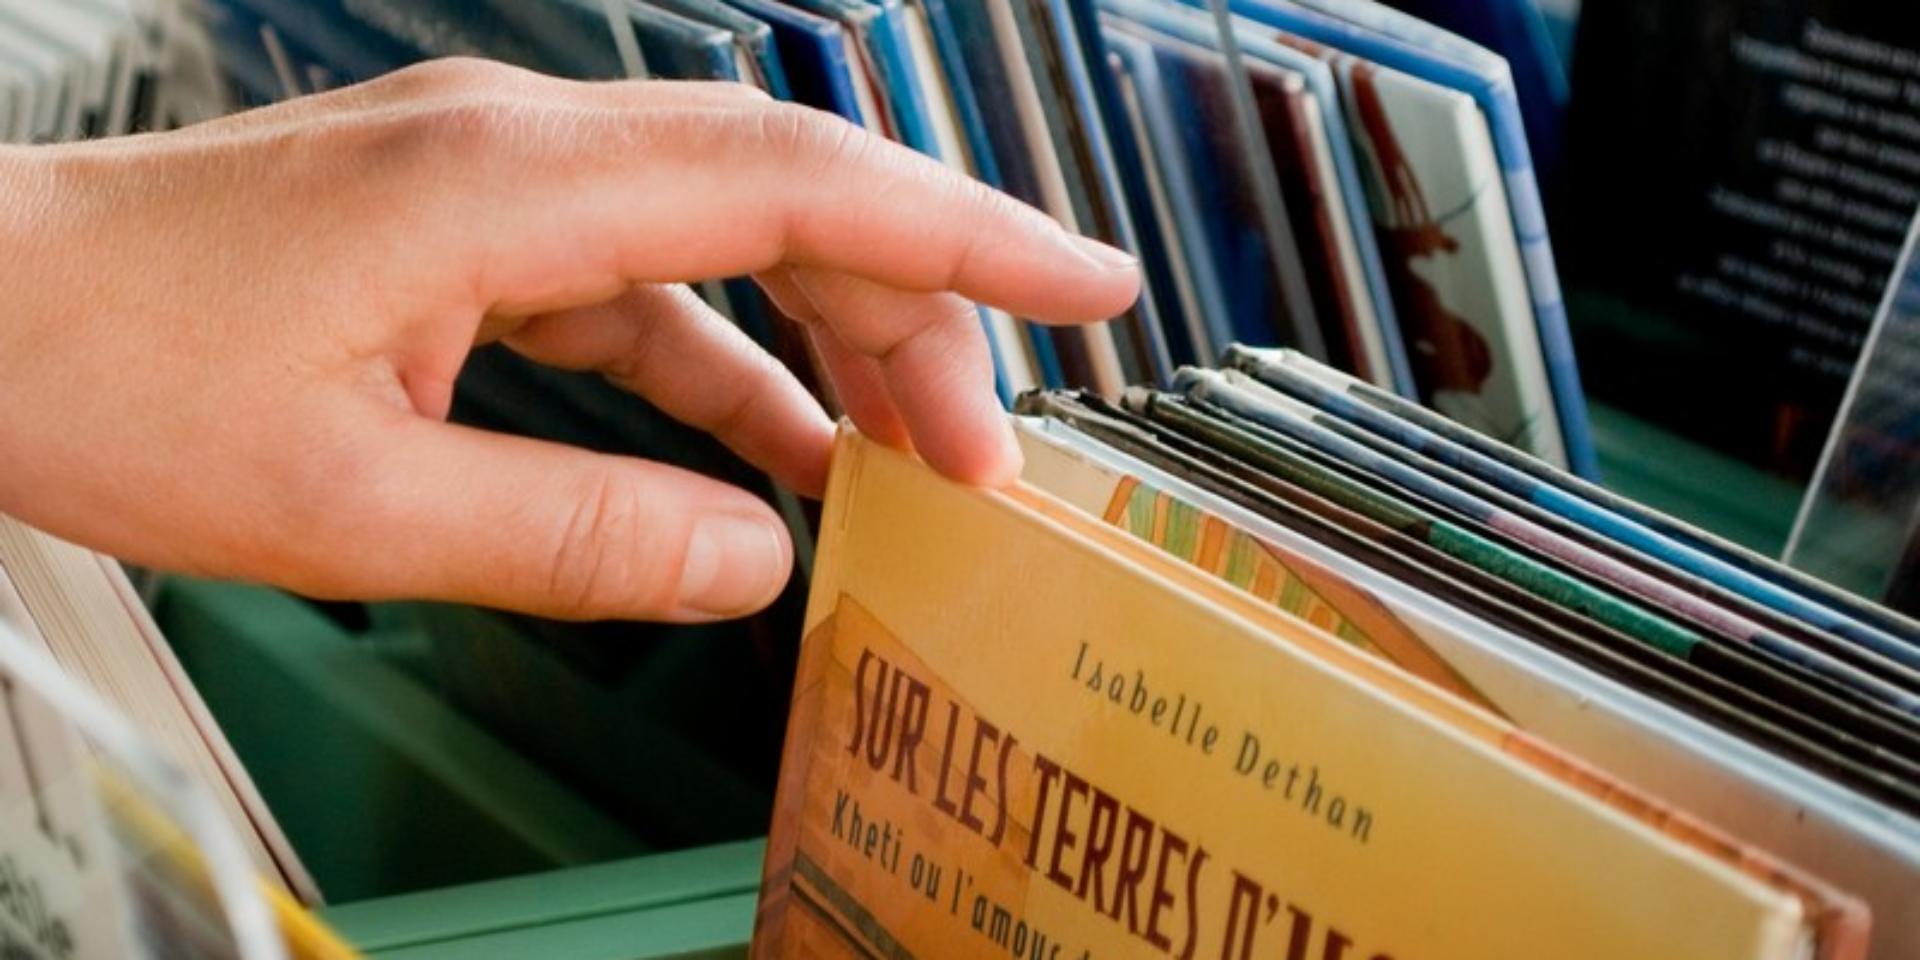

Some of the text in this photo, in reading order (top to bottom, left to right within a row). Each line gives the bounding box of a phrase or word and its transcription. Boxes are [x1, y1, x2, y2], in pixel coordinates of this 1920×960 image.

[845, 647, 931, 795] SUR
[931, 699, 1019, 848] LES
[1022, 752, 1211, 960] TERRES
[1071, 641, 1374, 844] Isabelle Dethan
[831, 788, 904, 874] Kheti
[910, 853, 943, 902] ou
